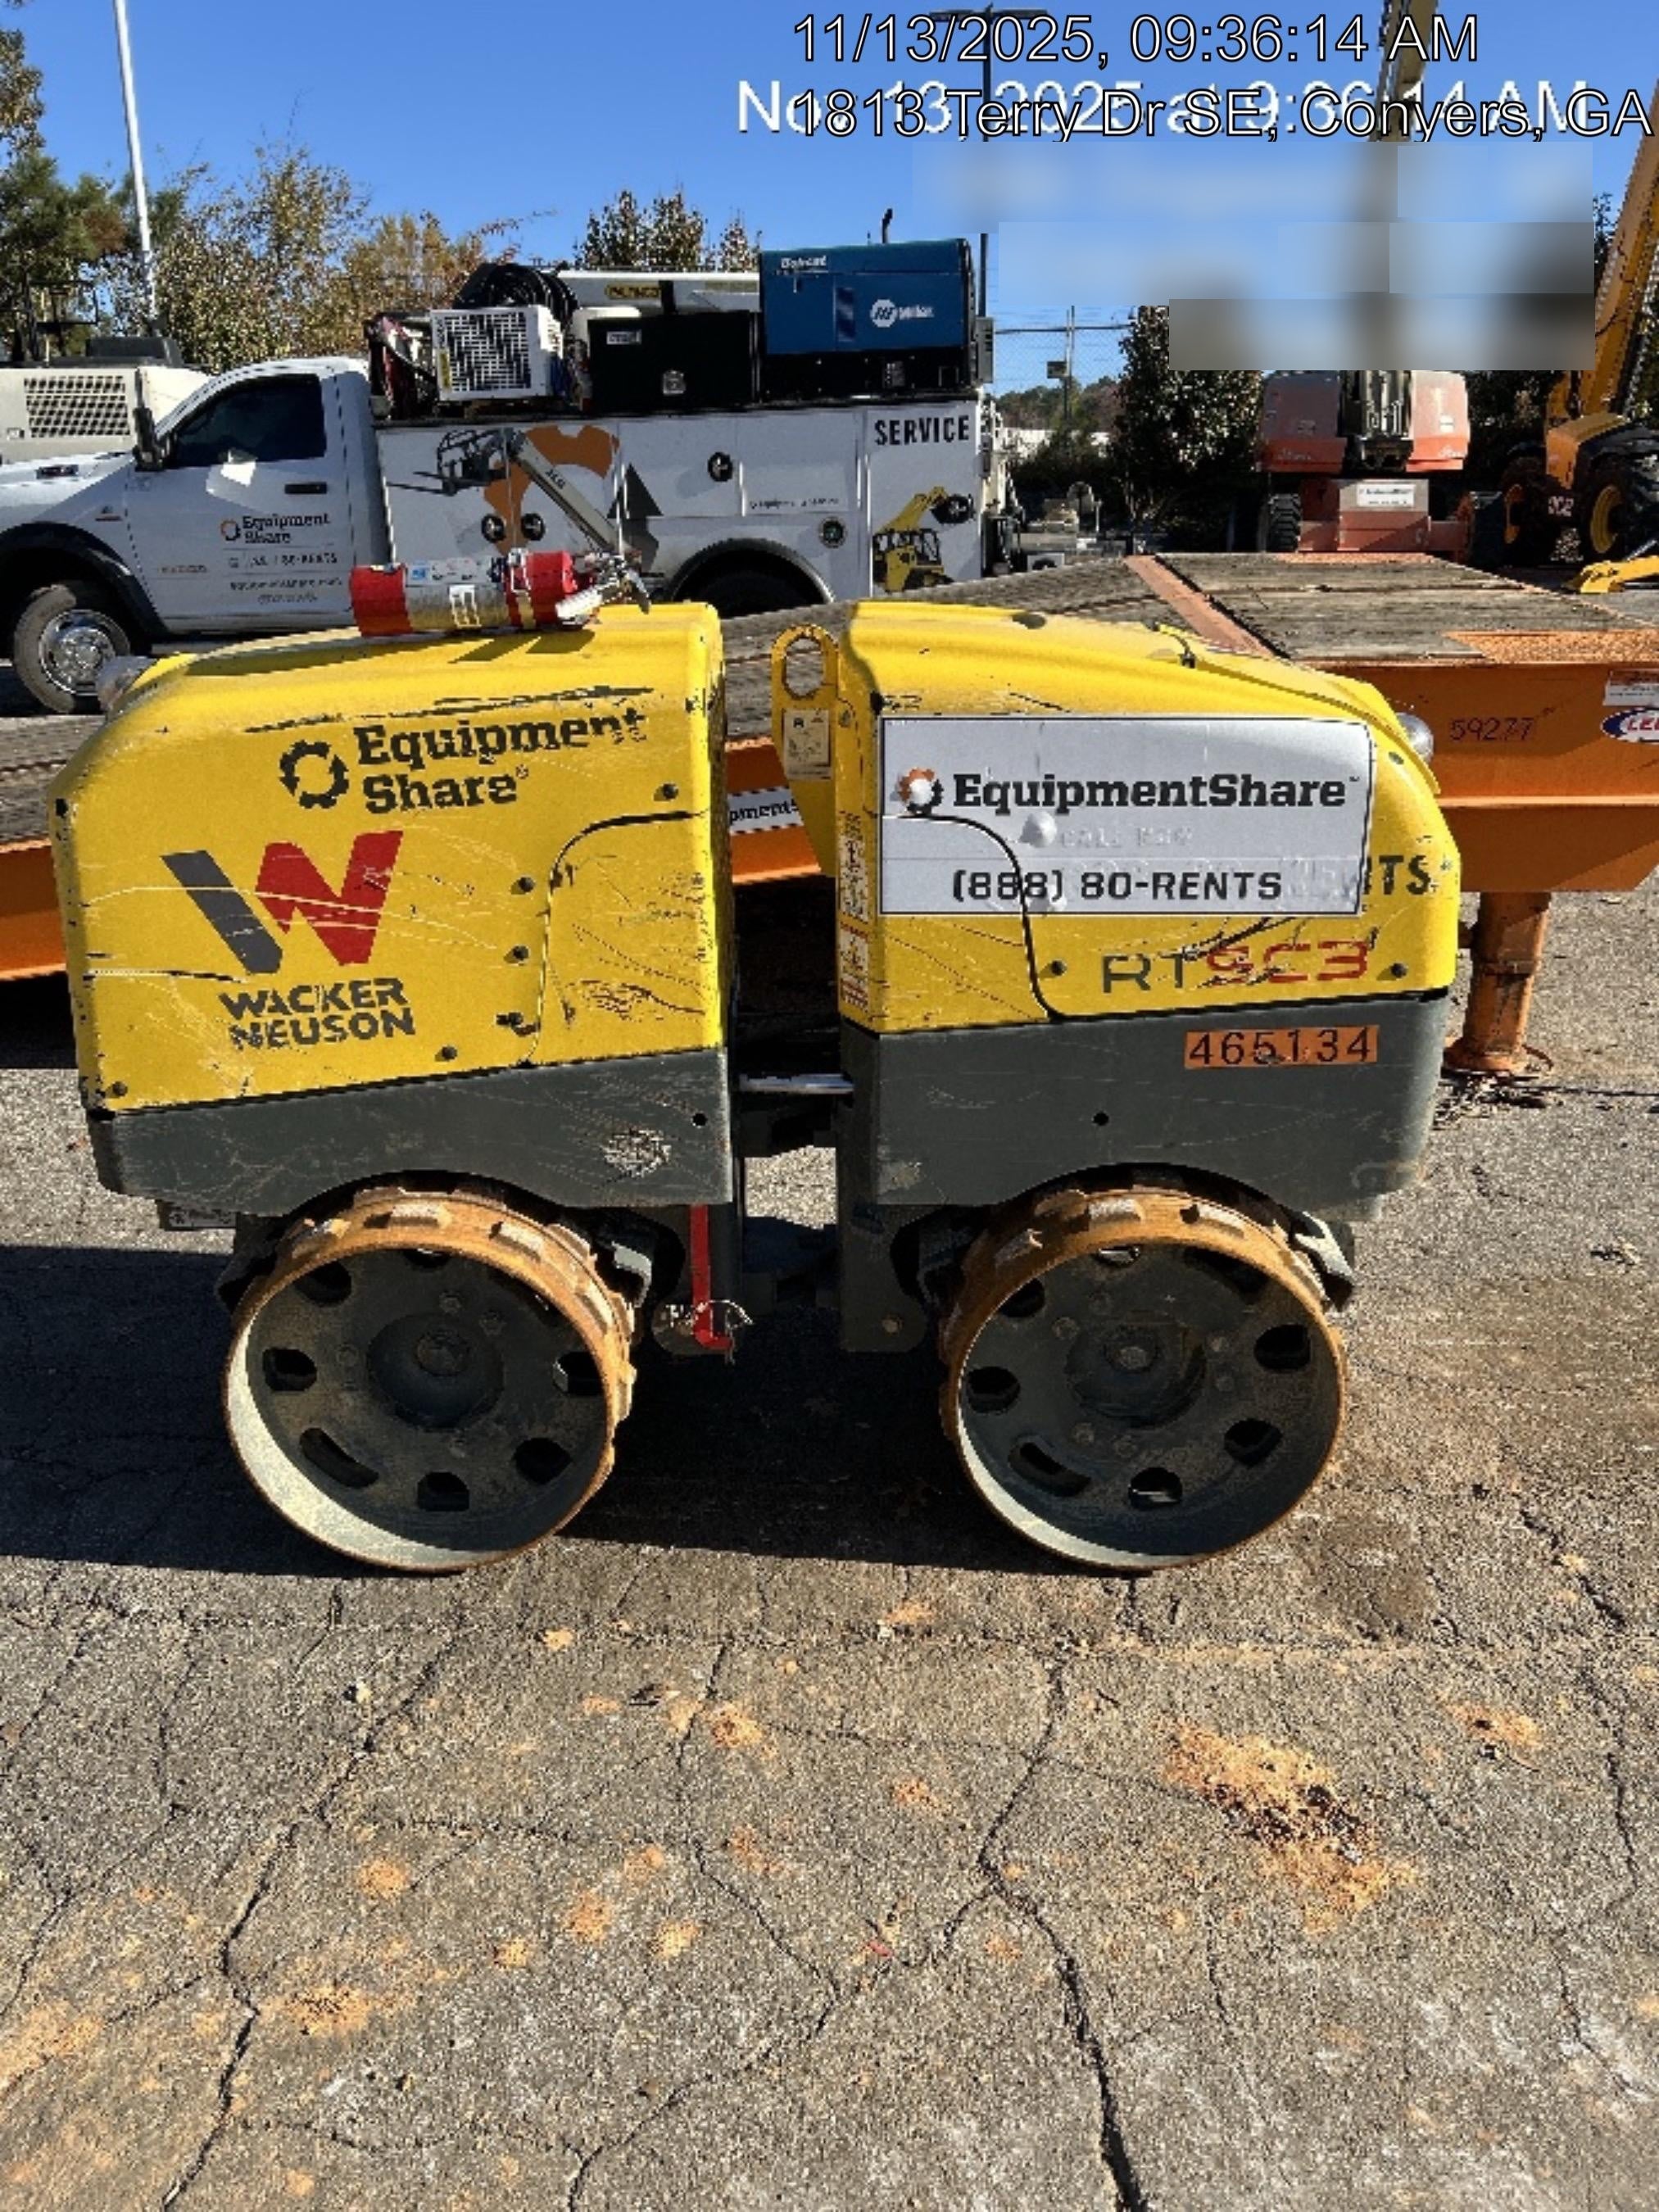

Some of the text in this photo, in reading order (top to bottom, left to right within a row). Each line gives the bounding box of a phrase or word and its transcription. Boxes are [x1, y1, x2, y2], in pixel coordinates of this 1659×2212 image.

[874, 415, 970, 446] SERVICE
[353, 707, 647, 772] Equipment
[1449, 717, 1535, 741] 59277
[362, 773, 518, 814] Share
[953, 773, 1346, 816] EquipmentShare
[953, 869, 1282, 903] (888) 80-RENTS
[218, 977, 409, 1021] WACKER
[228, 1007, 416, 1050] NEUSON
[1189, 1027, 1371, 1065] 465134
